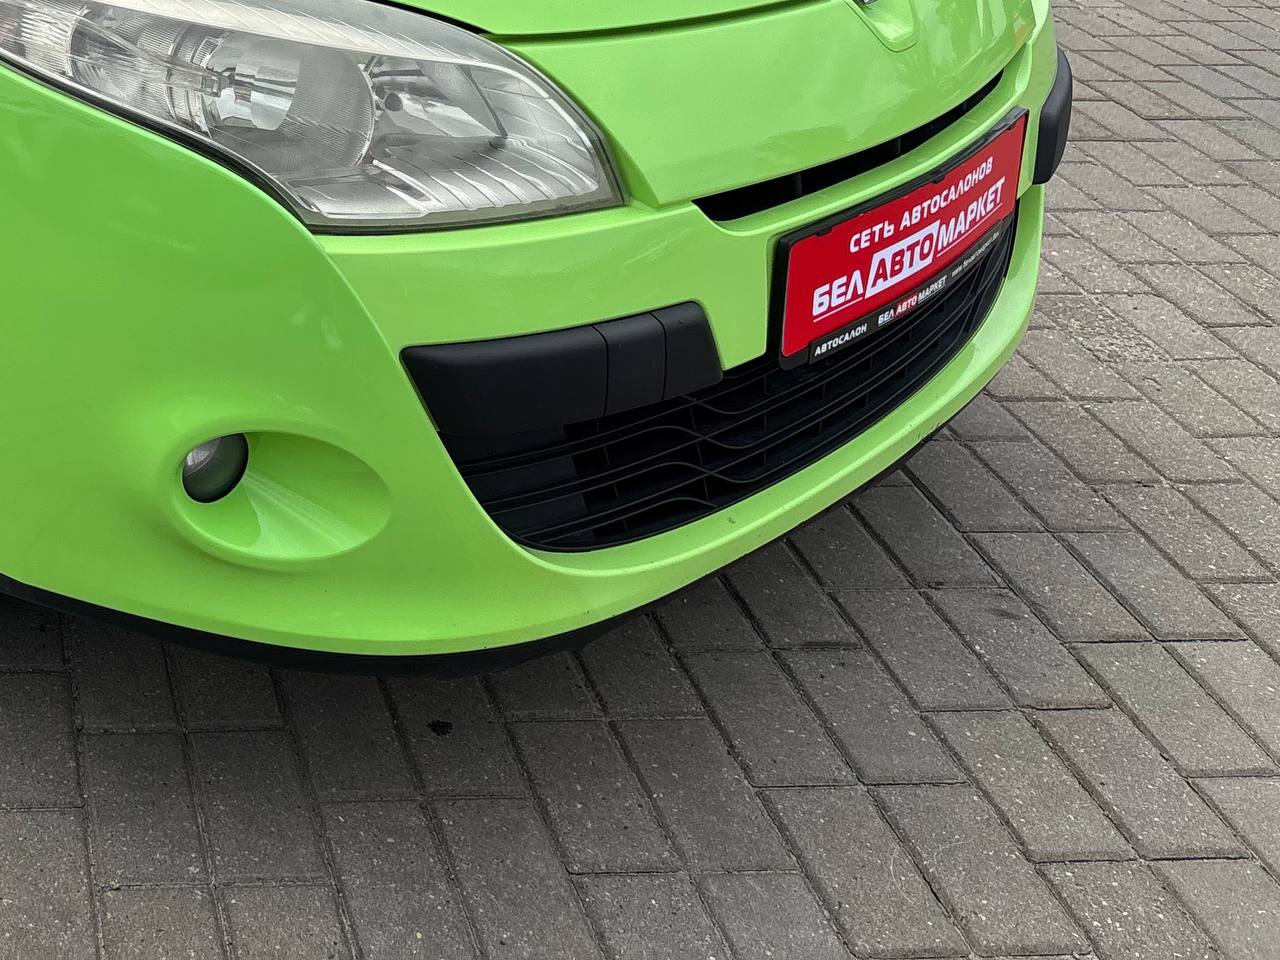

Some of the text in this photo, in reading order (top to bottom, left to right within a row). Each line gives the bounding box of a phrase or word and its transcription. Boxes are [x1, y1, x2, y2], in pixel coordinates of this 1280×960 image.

[812, 269, 864, 317] БЕЛ
[871, 233, 934, 288] АВТО
[937, 176, 1006, 252] МАРКЕТ
[849, 156, 994, 253] СЕТЬ АВТОСАЛОНОВ
[814, 275, 947, 357] АВТОСАЛОН БЕЛ АВТО МАРКЕТ
